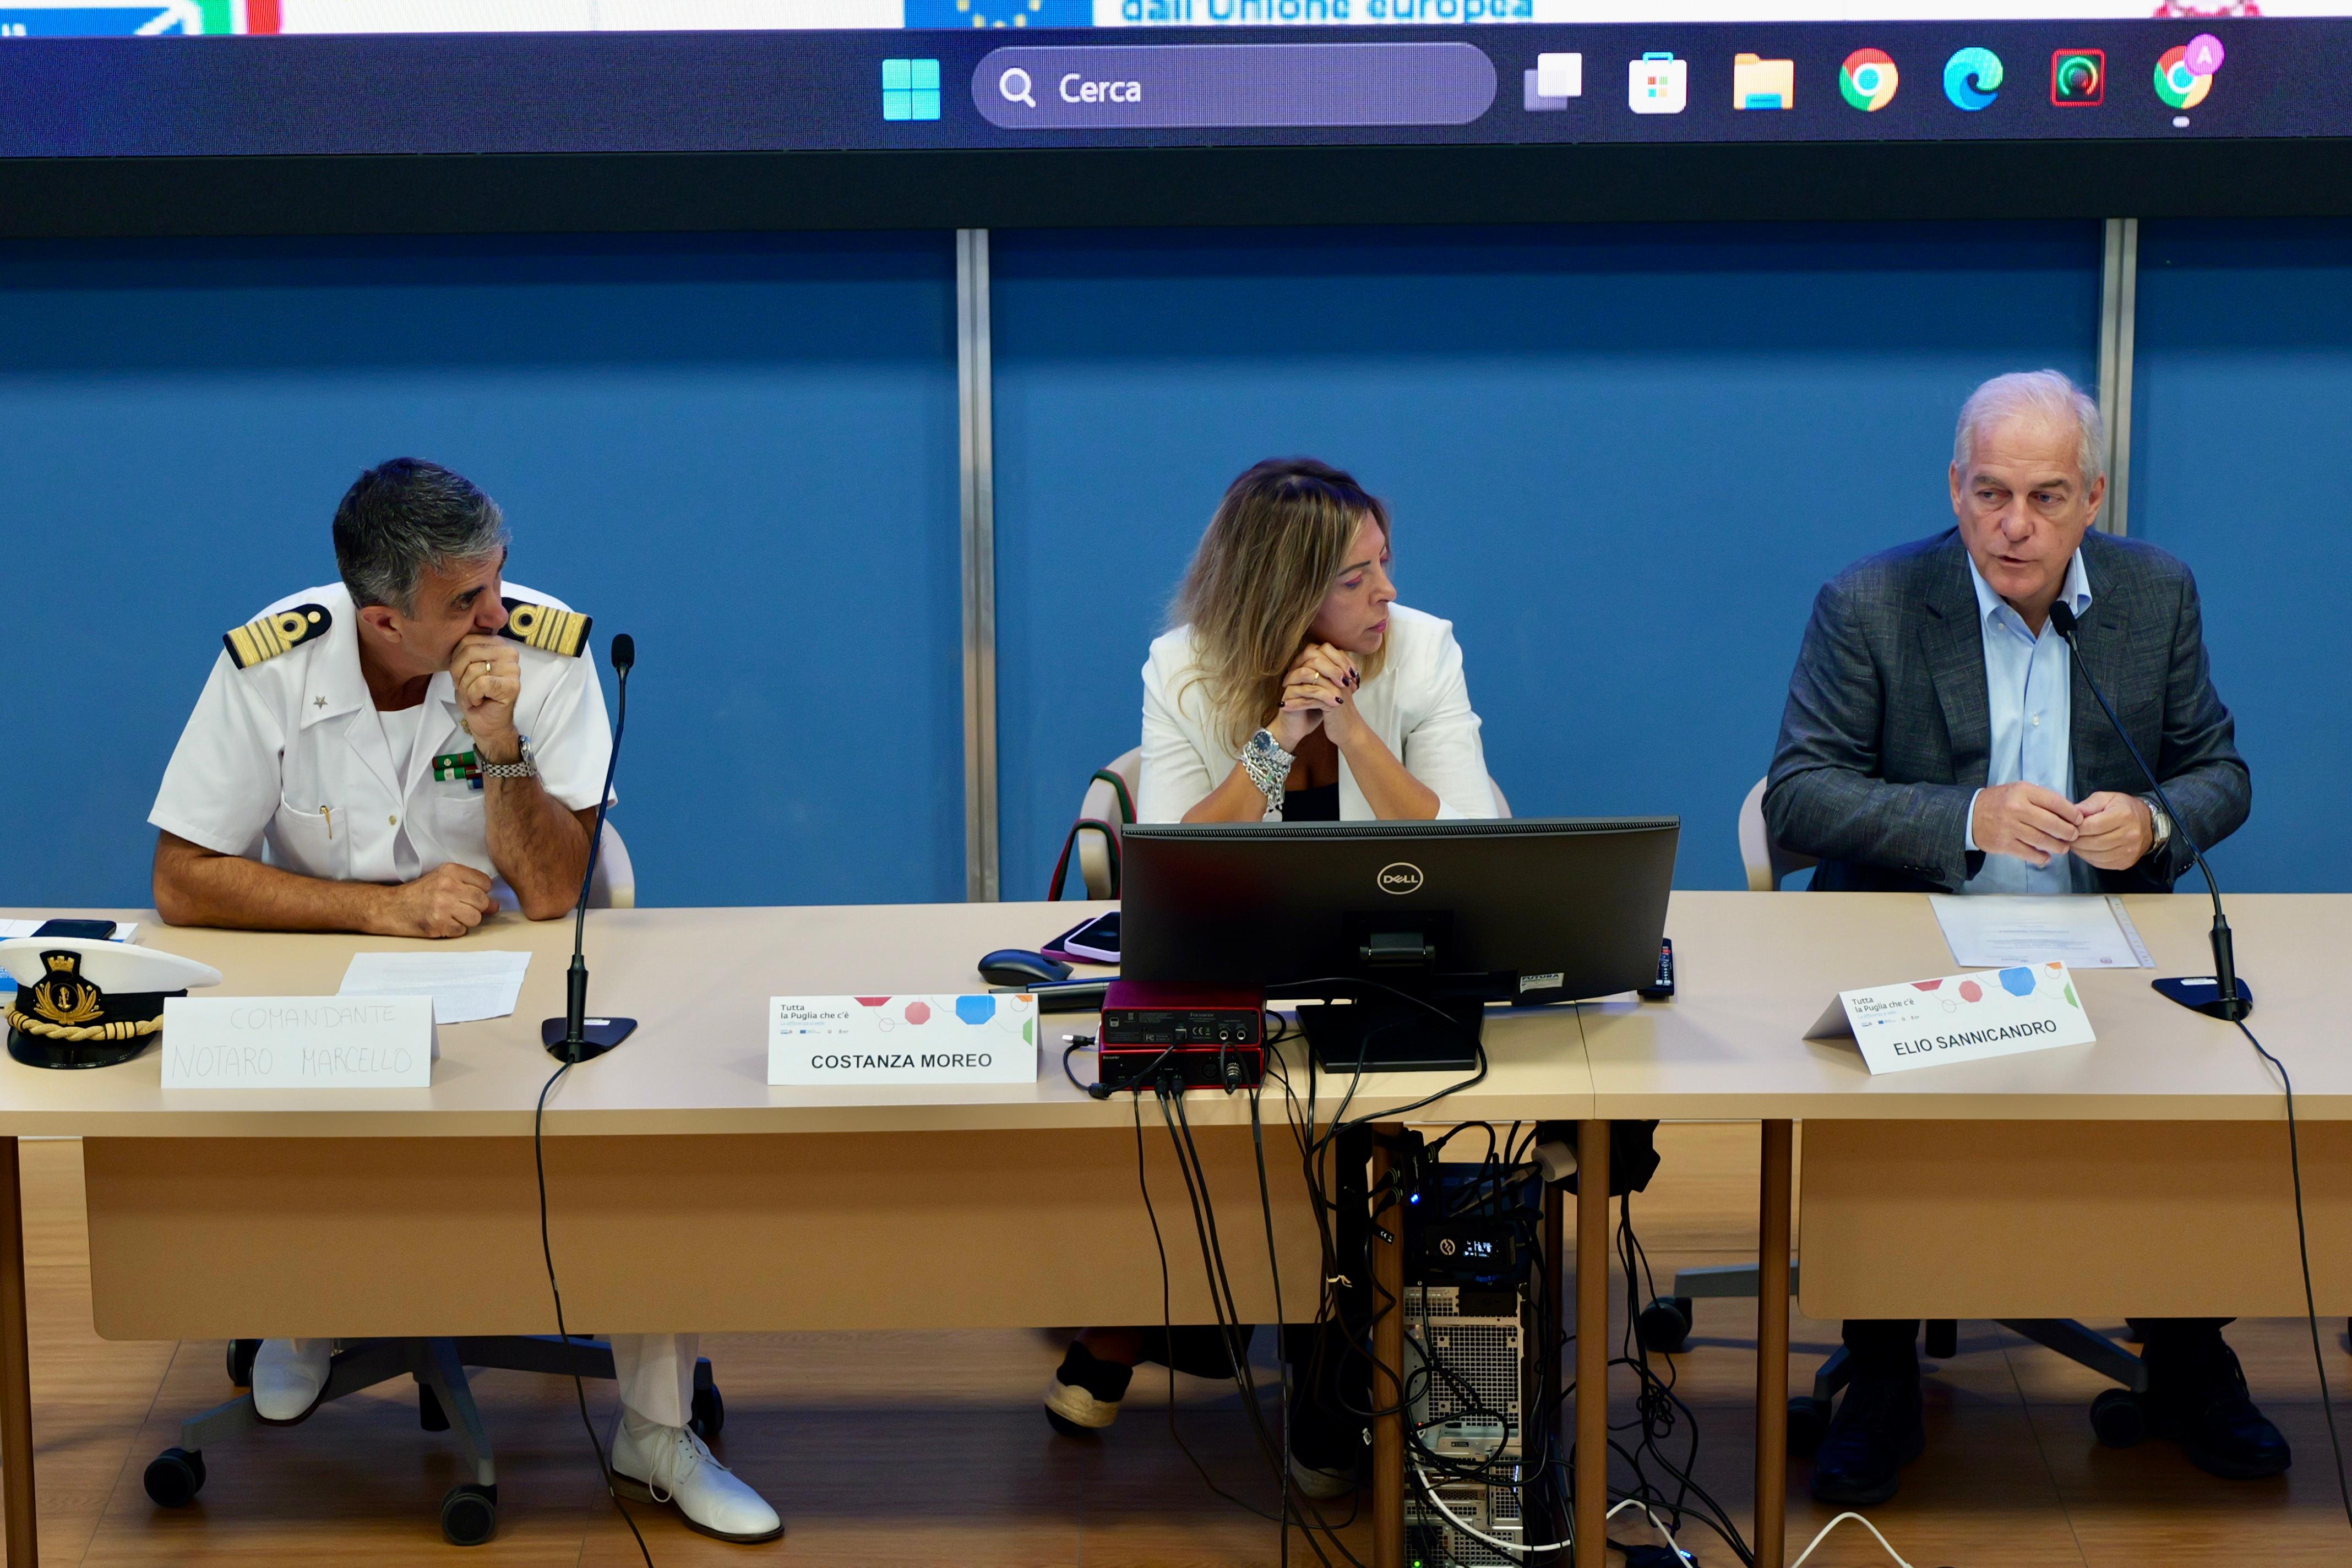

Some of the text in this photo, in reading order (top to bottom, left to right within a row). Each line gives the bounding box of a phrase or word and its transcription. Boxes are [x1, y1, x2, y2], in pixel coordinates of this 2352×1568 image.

[1122, 0, 1350, 21] dallUnione
[1059, 73, 1141, 104] Cerca
[1383, 874, 1419, 884] DELL
[1852, 997, 1874, 1005] Tutta
[1864, 1003, 1887, 1012] Puglia
[230, 1005, 396, 1030] COMANDANTE
[791, 1012, 818, 1020] Puglia
[1893, 1038, 1933, 1056] ELIO
[1936, 1019, 2057, 1049] SANNICANDRO
[171, 1044, 412, 1079] NOTARO MARCELLO
[811, 1053, 993, 1069] COSTANZA MOREO
